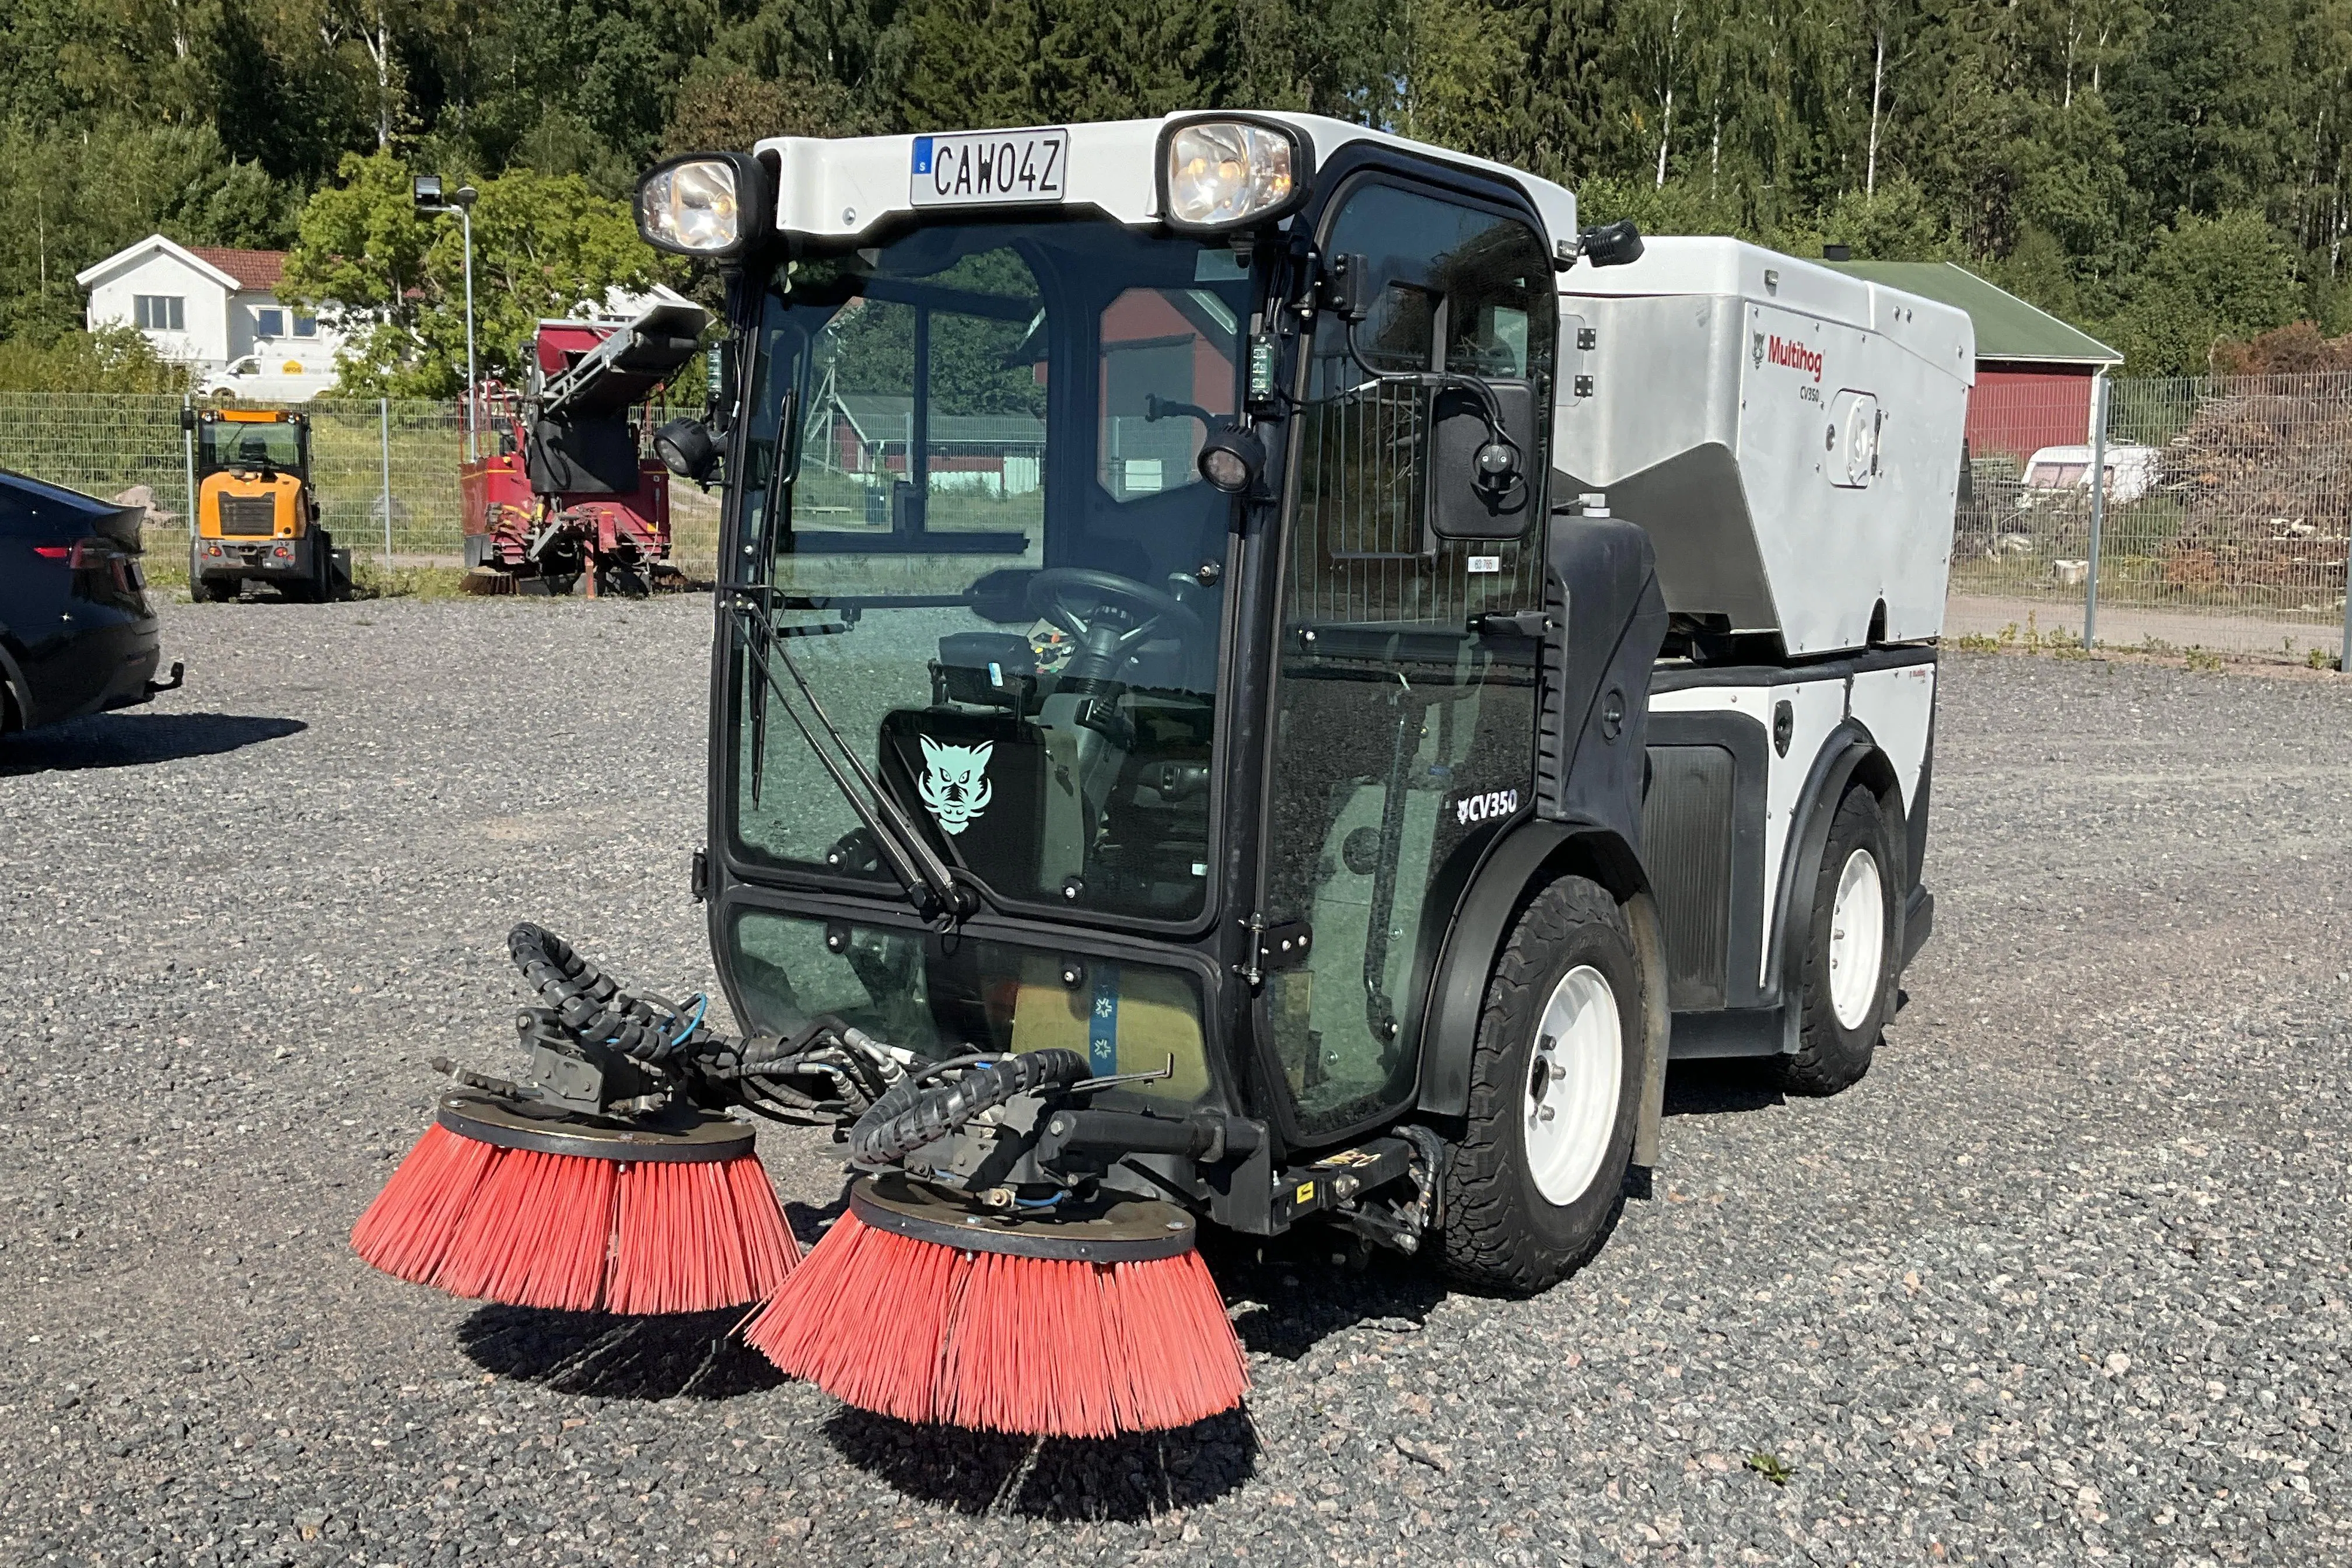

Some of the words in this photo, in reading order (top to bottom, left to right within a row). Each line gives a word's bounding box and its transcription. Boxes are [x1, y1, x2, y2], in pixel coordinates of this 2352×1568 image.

[919, 161, 926, 172] S
[1768, 334, 1823, 383] Multihog
[1800, 386, 1820, 402] CV350
[1468, 789, 1518, 822] CV350
